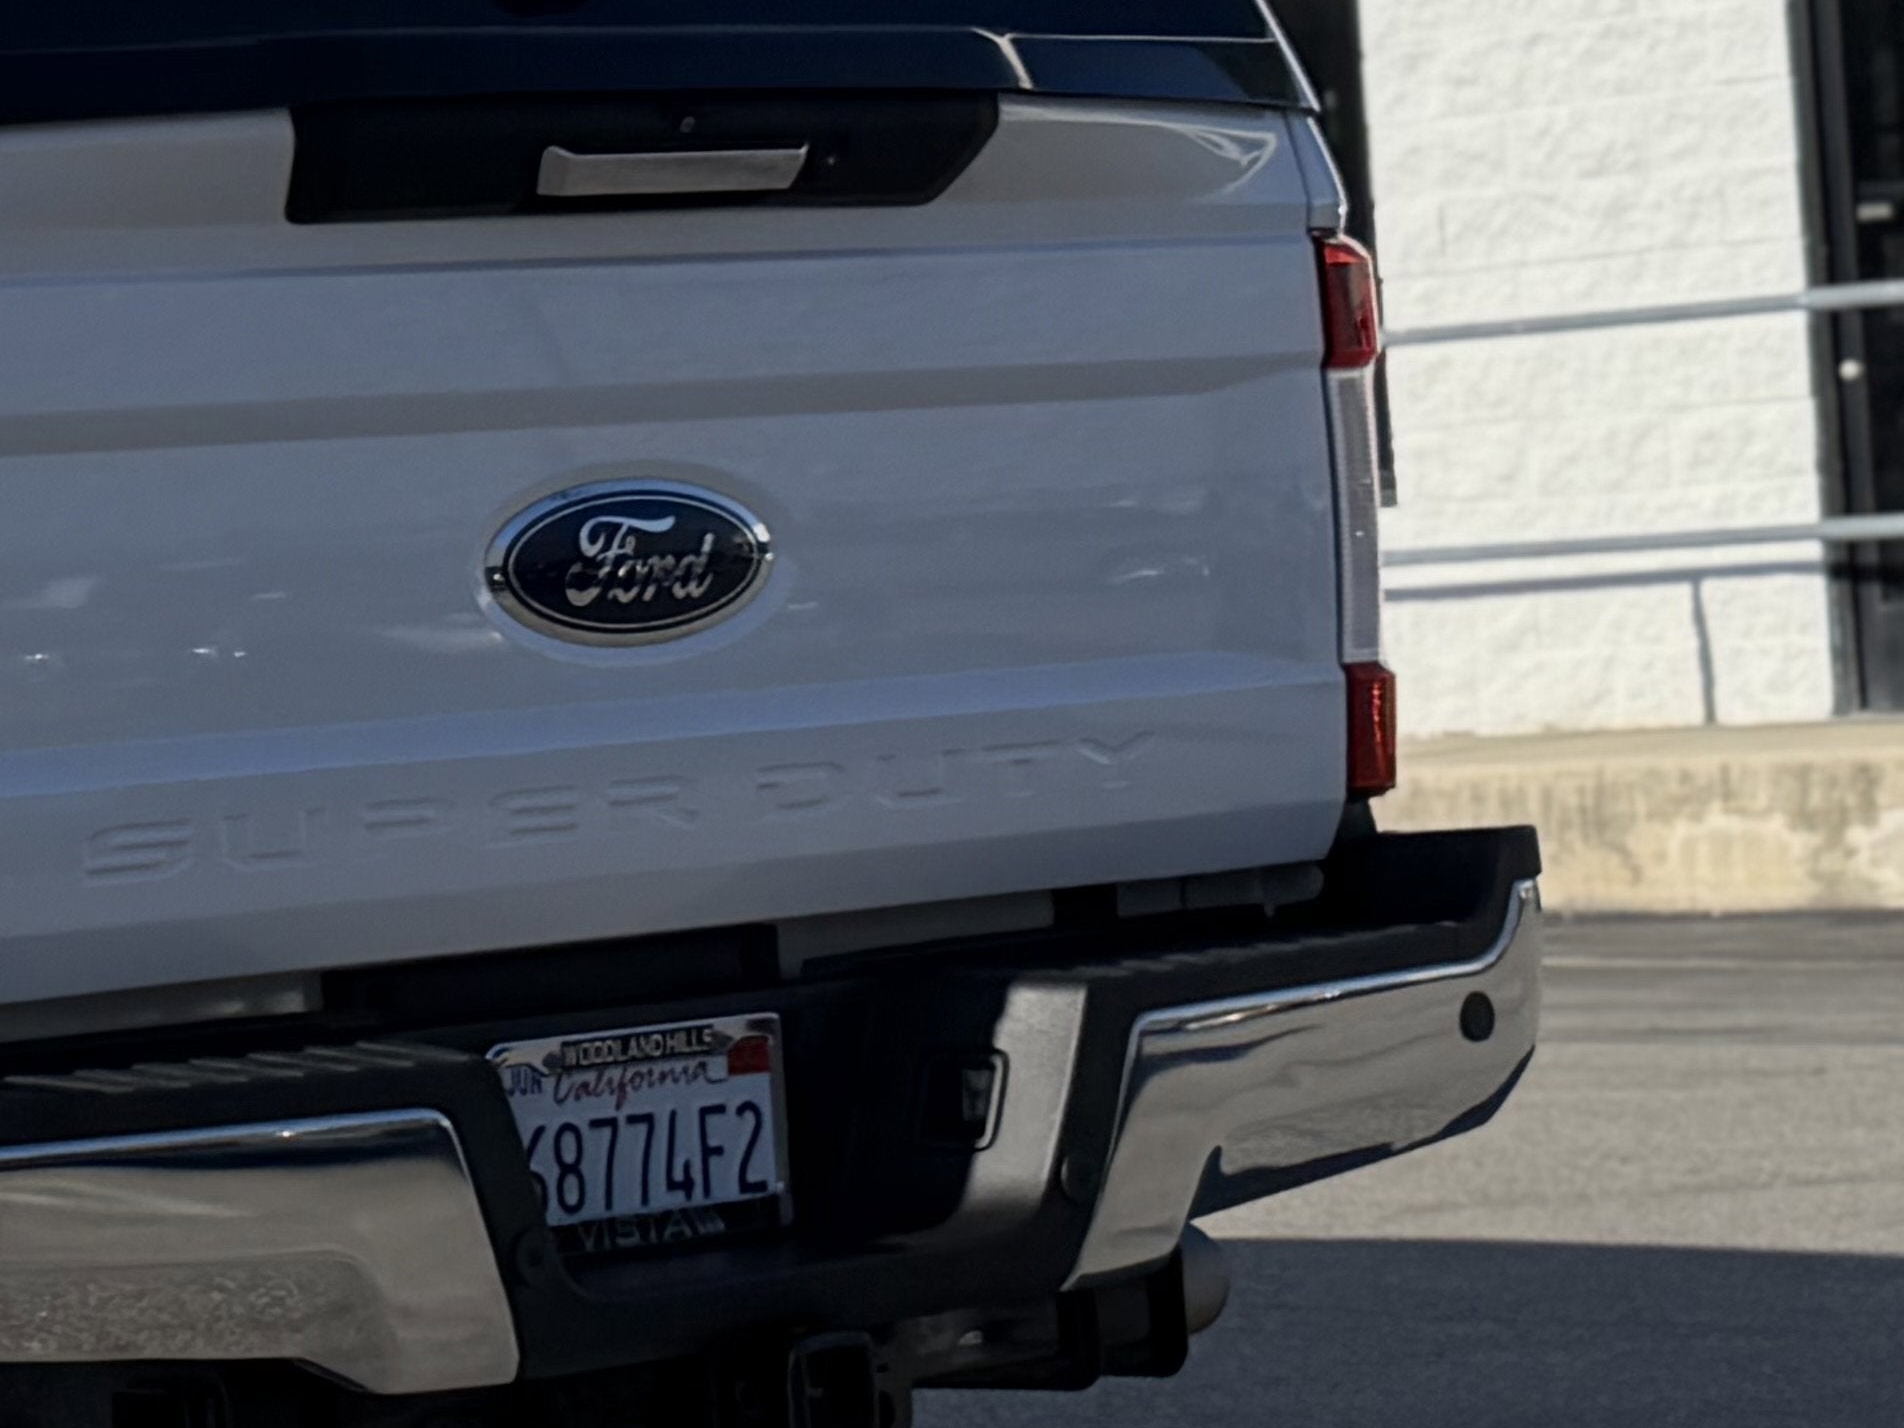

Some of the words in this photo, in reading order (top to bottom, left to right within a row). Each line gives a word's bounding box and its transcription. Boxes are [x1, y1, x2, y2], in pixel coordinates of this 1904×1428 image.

[564, 514, 715, 608] Ford
[84, 774, 704, 889] SUPER
[754, 730, 1157, 823] DUTY
[563, 1033, 665, 1067] WOODLAND
[667, 1027, 713, 1053] HILLS
[553, 1059, 729, 1111] California
